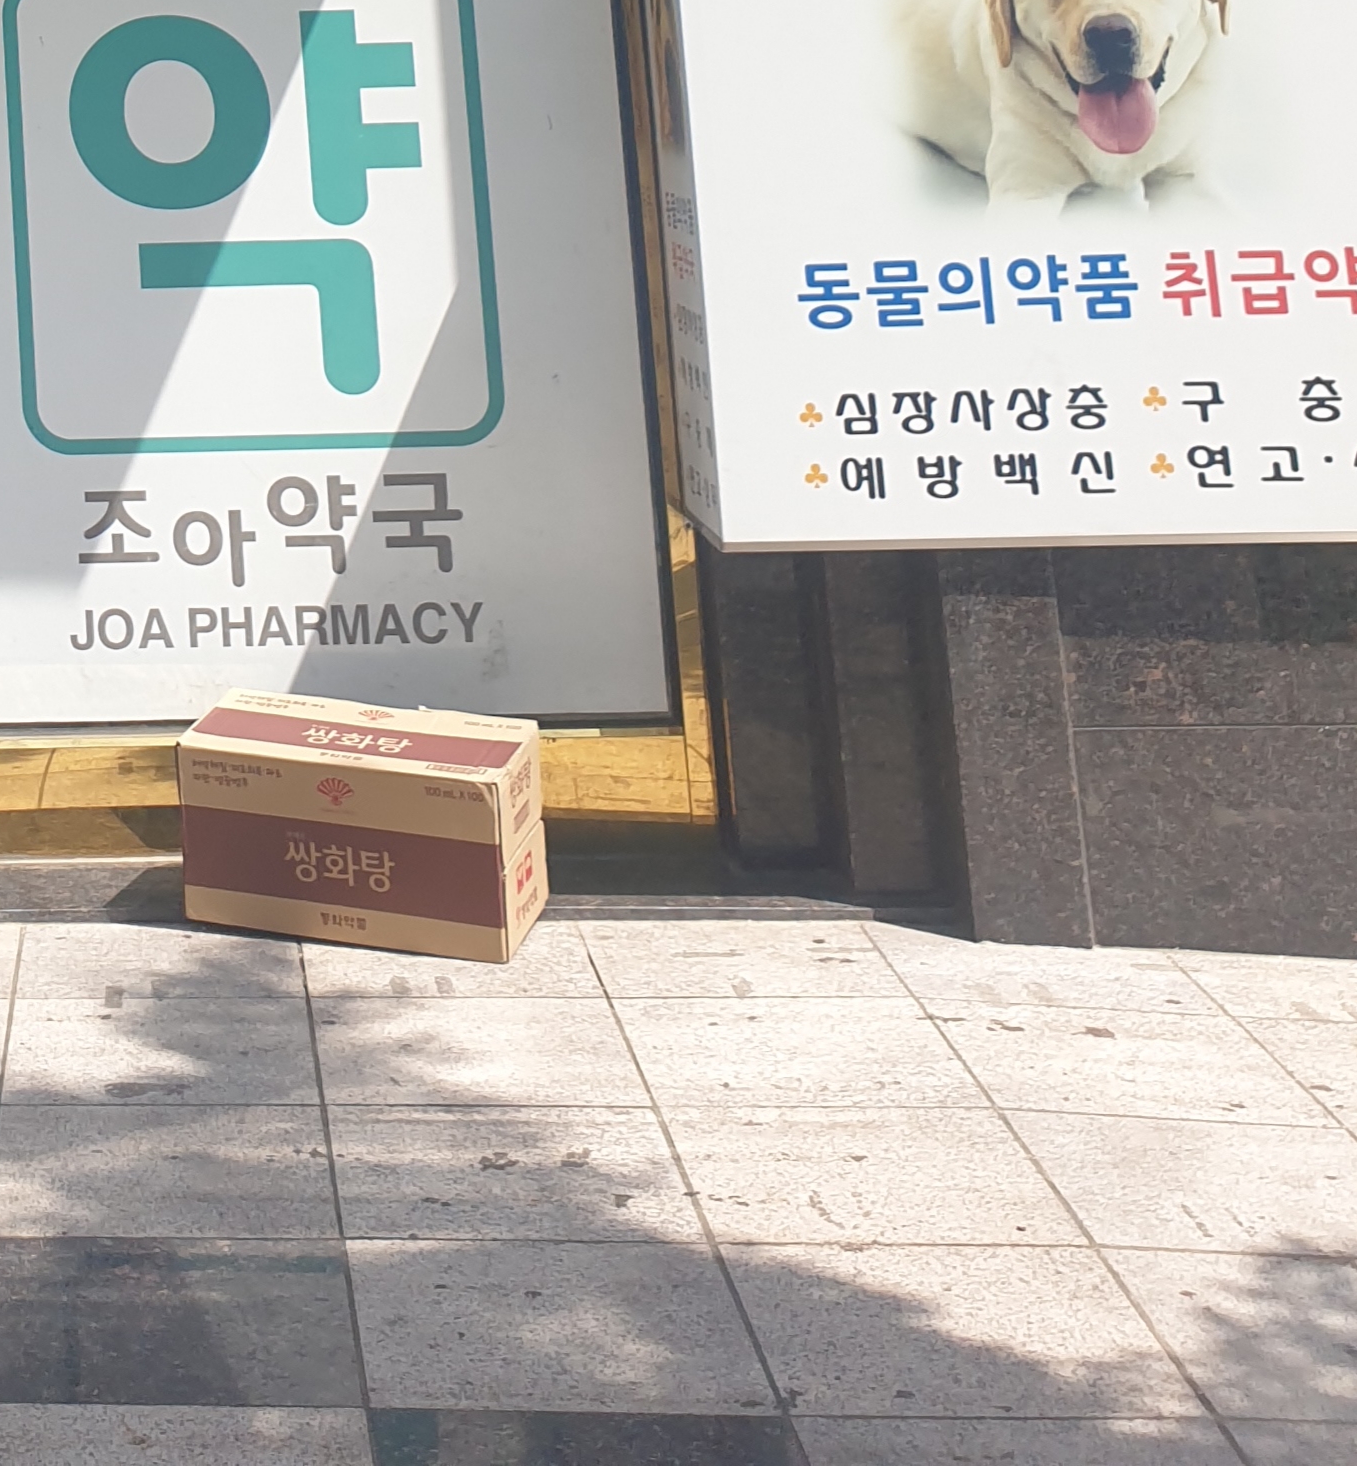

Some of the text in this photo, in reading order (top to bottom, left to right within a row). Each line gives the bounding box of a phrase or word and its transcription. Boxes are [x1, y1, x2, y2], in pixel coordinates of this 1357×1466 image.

[68, 8, 423, 396] 약
[796, 253, 1139, 330] 동물의약품
[835, 385, 1109, 435] 심장사상충
[77, 471, 464, 589] 조아약국
[69, 601, 484, 651] JOA PHARMACY
[301, 726, 413, 754] 쌍화탕
[424, 785, 441, 797] 100
[284, 840, 396, 893] 쌍화탕
